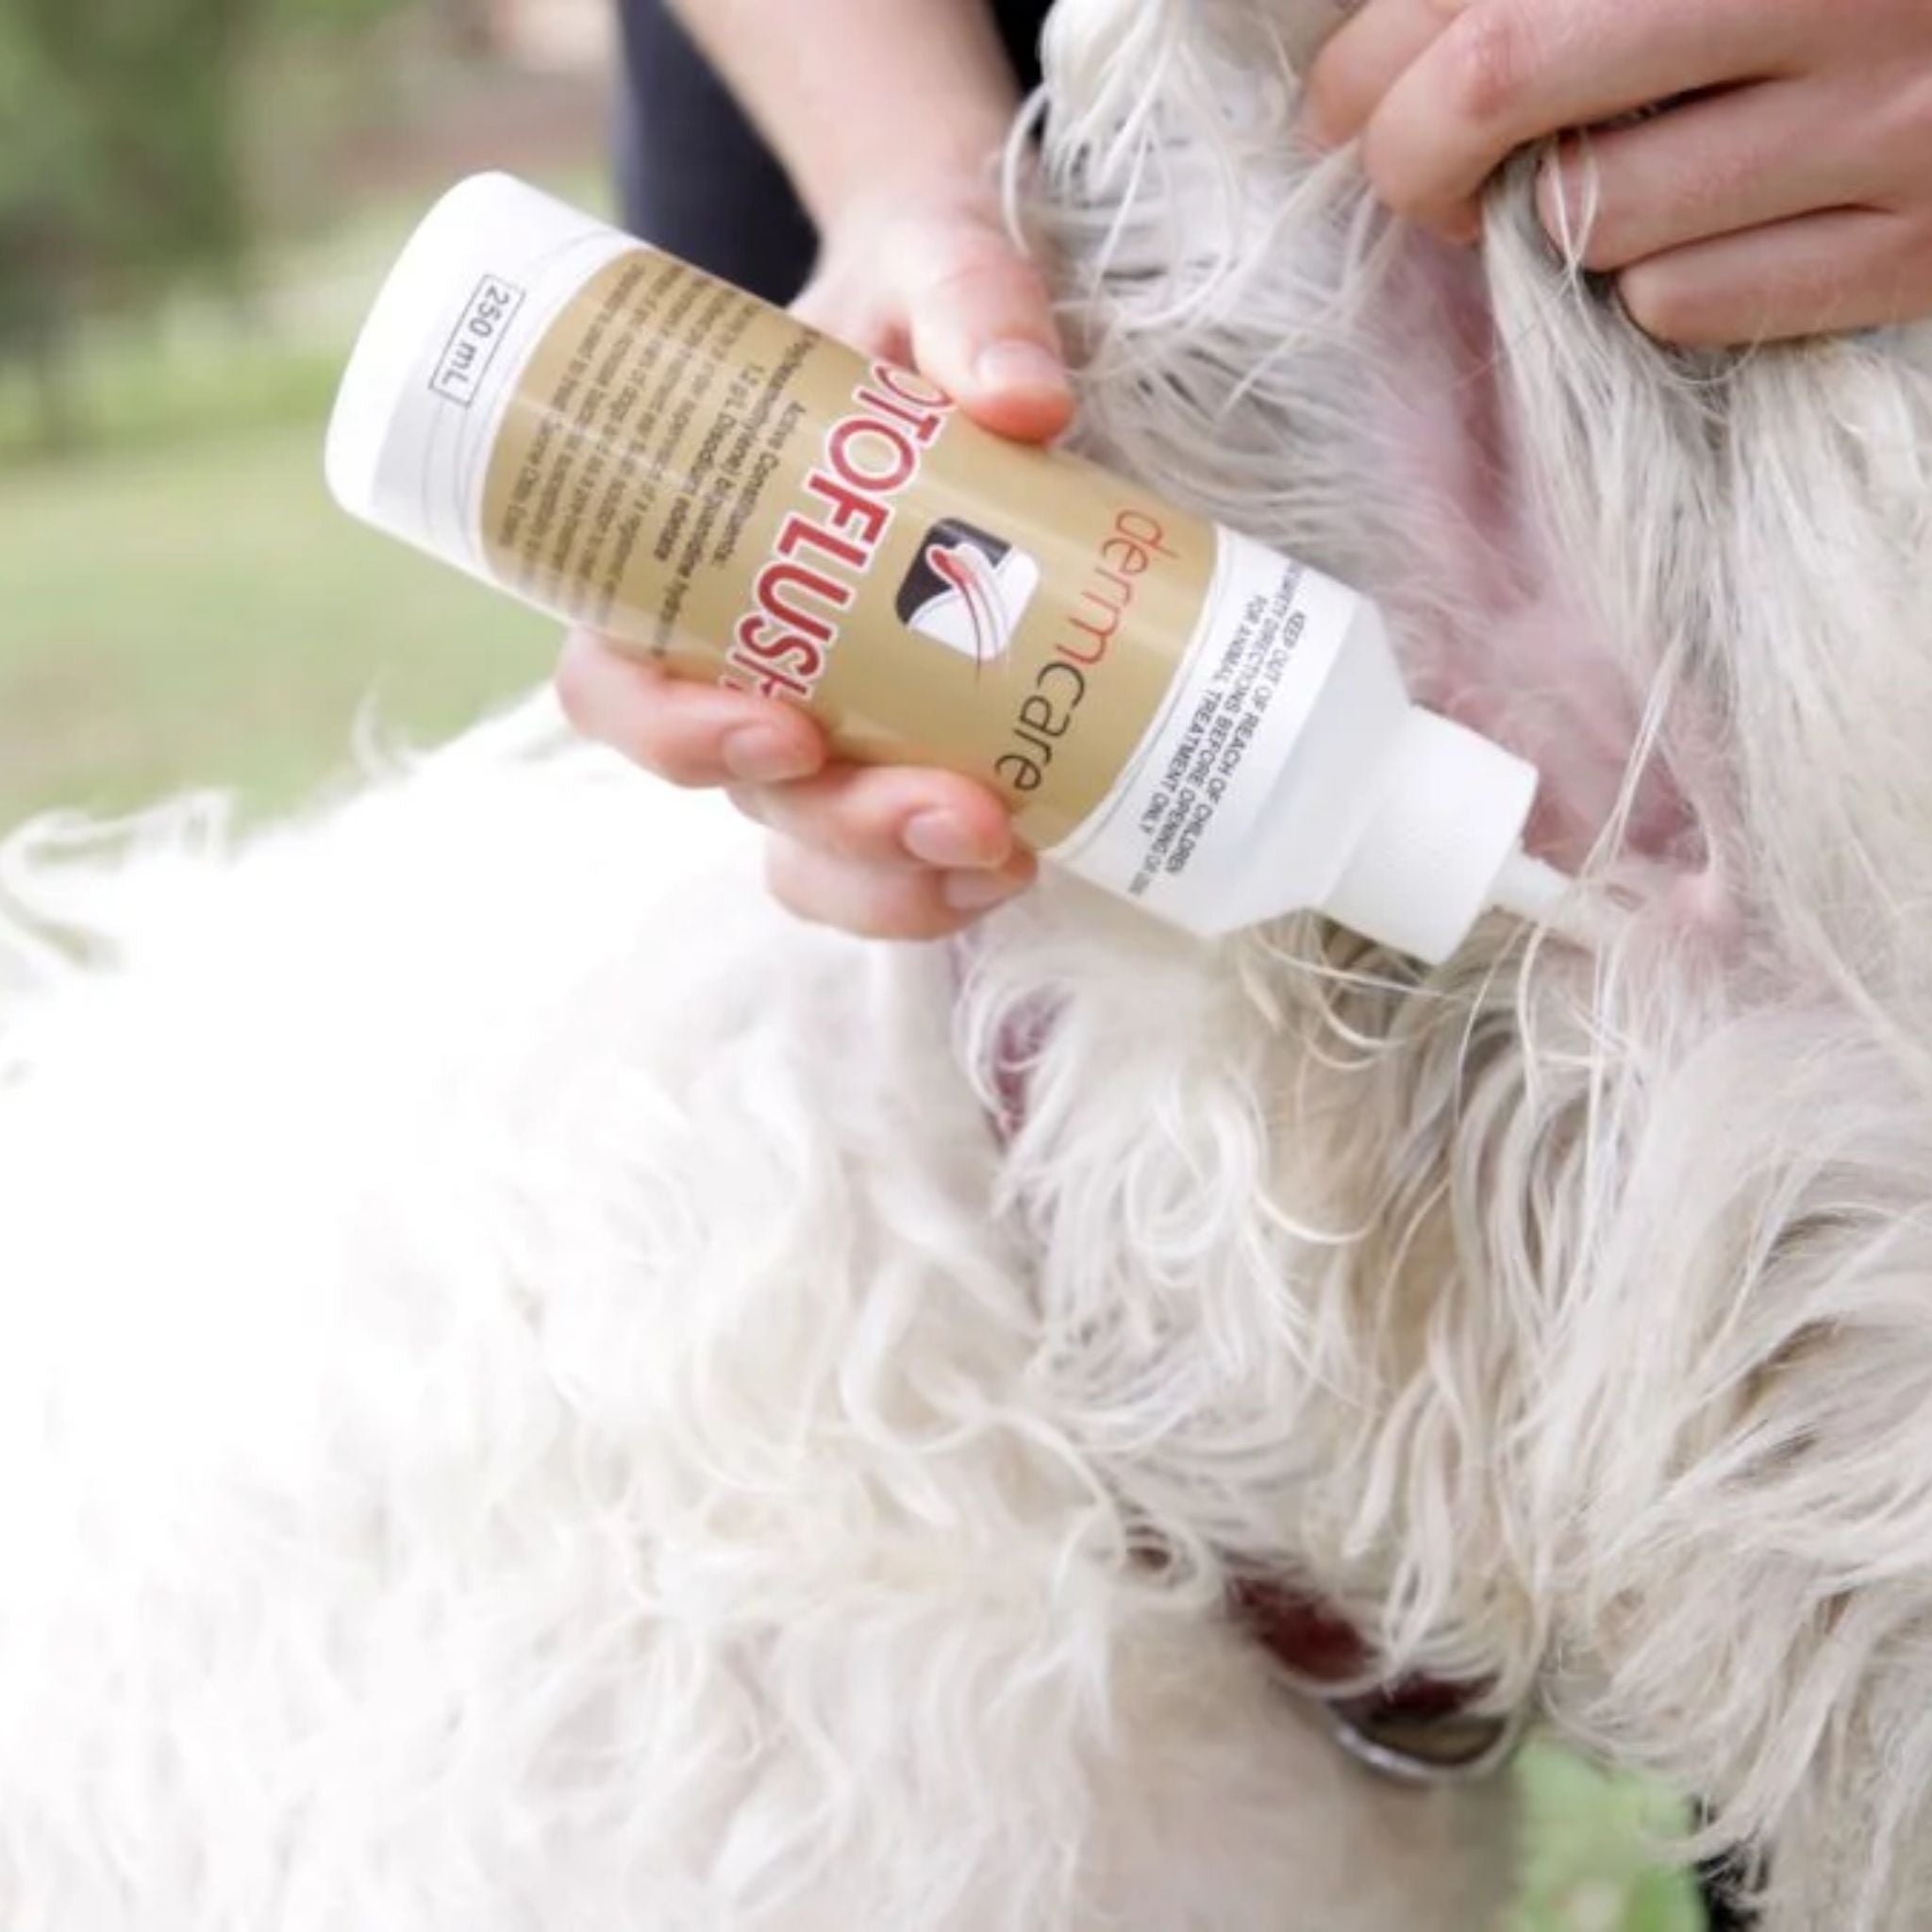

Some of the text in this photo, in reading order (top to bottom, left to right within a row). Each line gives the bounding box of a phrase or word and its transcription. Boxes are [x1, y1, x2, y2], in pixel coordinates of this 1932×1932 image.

[441, 284, 509, 385] 250 mL
[994, 509, 1179, 793] dermcare
[1278, 610, 1307, 649] KEEP
[1248, 684, 1273, 711] OF
[1261, 647, 1290, 684] OUT
[1160, 687, 1222, 791] TREATMENT
[1188, 715, 1232, 787] BEFORE
[1217, 710, 1259, 775] REACH
[1138, 791, 1171, 835] ONLY
[1203, 775, 1226, 803] OF
[1164, 802, 1213, 876] CHILDREN
